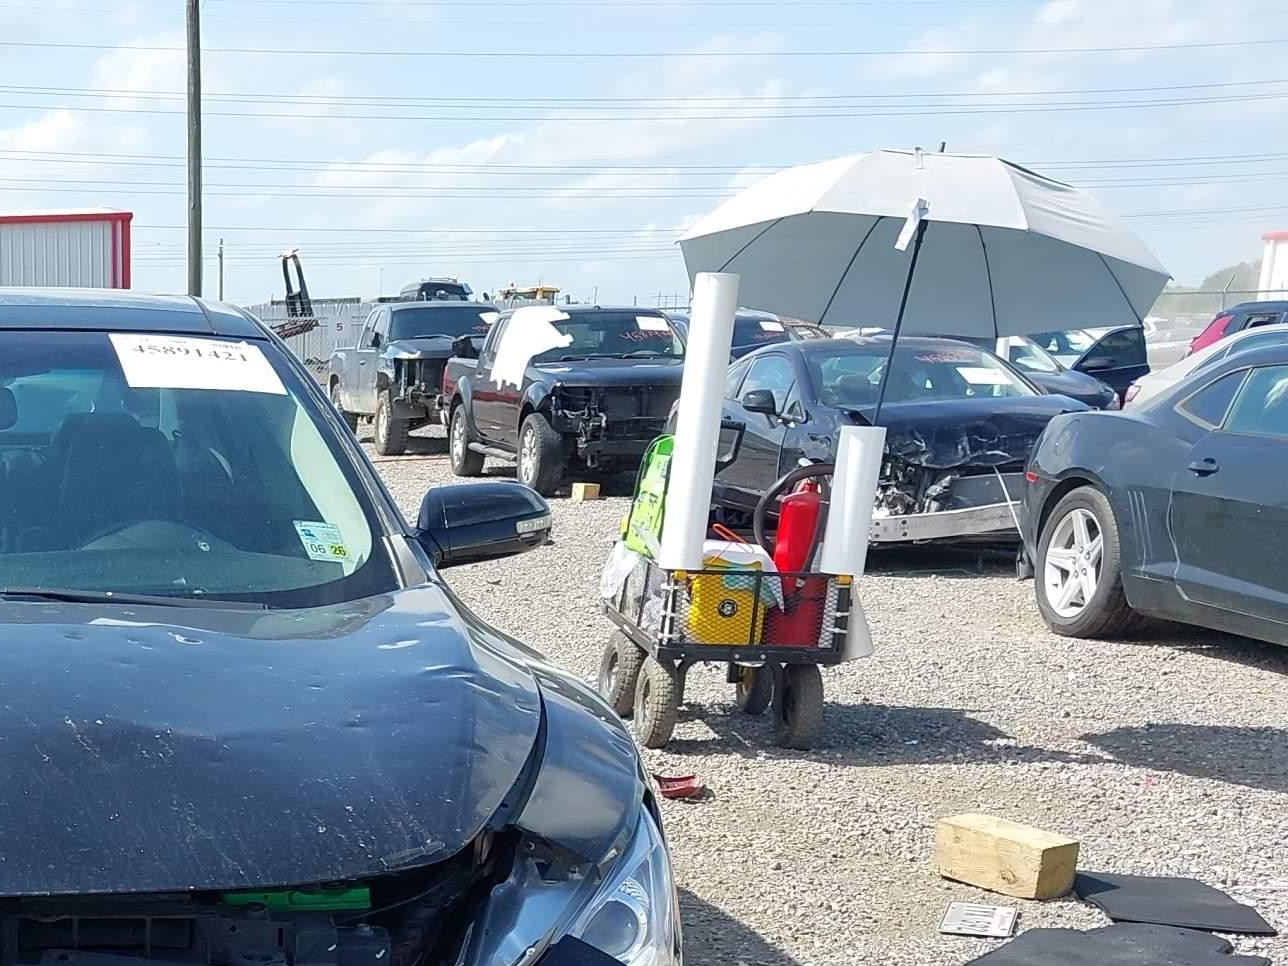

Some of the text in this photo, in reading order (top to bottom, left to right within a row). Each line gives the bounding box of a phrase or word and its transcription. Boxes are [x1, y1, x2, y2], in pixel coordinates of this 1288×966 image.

[336, 322, 344, 332] 5
[133, 344, 248, 362] 45891421
[310, 543, 347, 556] 06 26
